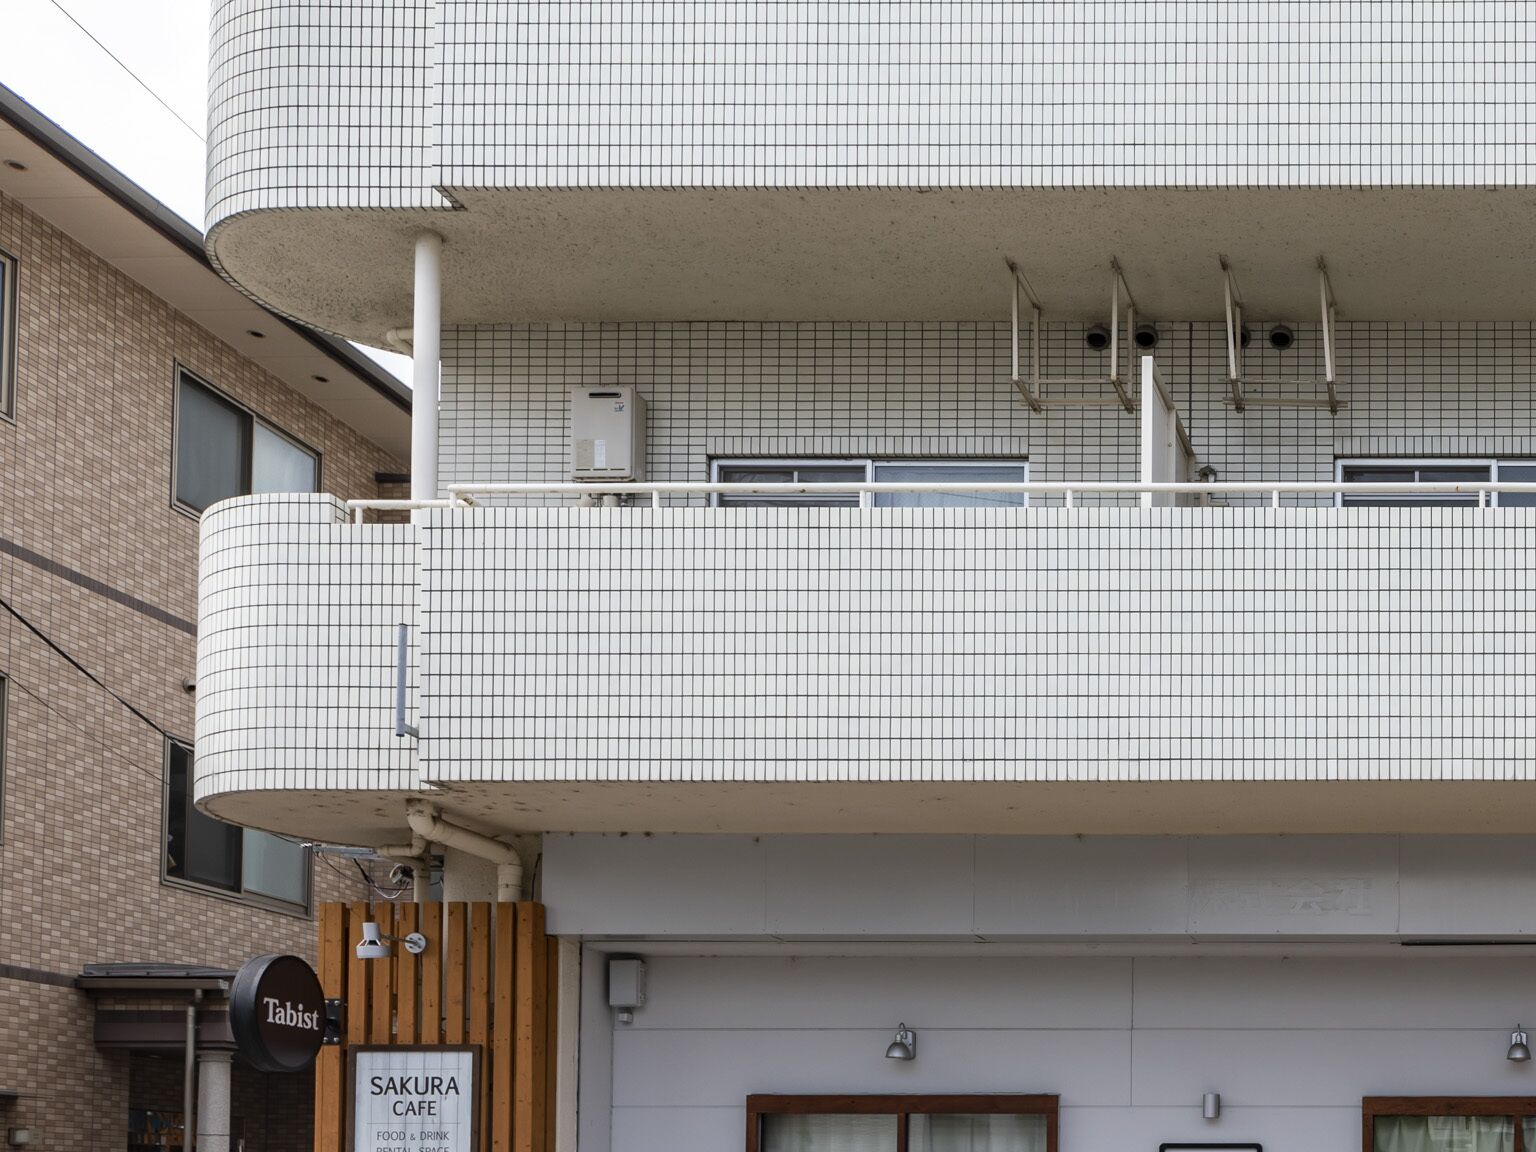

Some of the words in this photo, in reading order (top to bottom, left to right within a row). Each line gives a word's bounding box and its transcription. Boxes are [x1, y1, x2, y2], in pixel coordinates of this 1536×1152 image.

[263, 997, 320, 1031] Tabist
[370, 1075, 460, 1096] SAKURA
[392, 1100, 437, 1116] CAFE
[376, 1131, 406, 1141] FOOD
[410, 1132, 416, 1141] &
[419, 1131, 450, 1141] DRINK
